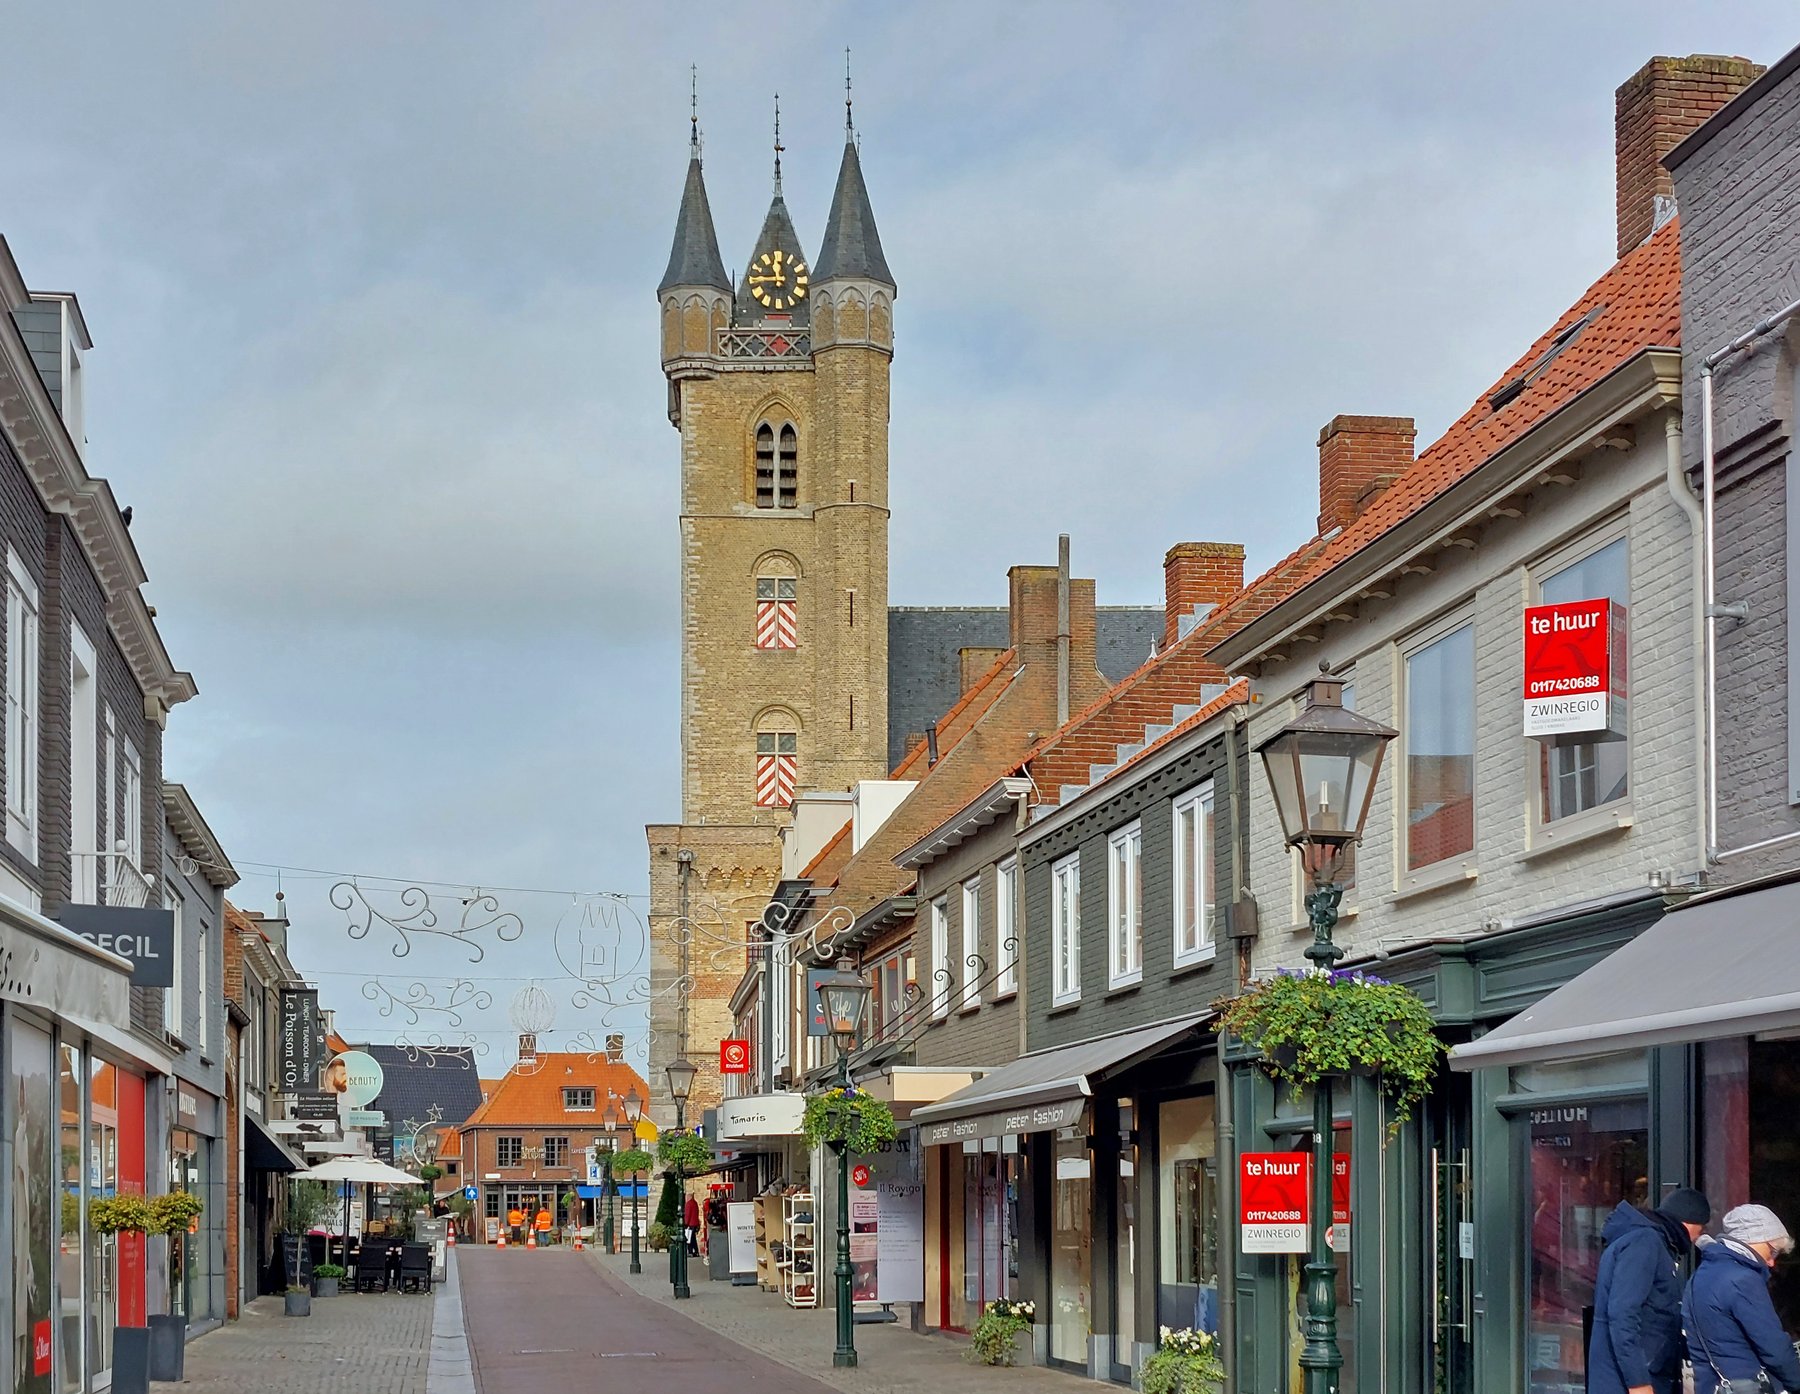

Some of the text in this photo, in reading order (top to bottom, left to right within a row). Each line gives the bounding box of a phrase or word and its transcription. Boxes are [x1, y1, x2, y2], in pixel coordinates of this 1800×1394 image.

[1531, 615, 1550, 635] te
[1553, 611, 1600, 632] huur
[1530, 675, 1600, 693] 0117420688
[1531, 699, 1600, 717] ZWINREGIO
[285, 994, 297, 1089] Le Poisson d'Or
[730, 1113, 766, 1125] Tamaris
[1005, 1114, 1029, 1132] peter
[1246, 1159, 1300, 1175] te huur
[1247, 1211, 1301, 1220] 0117420688
[1247, 1229, 1301, 1239] ZWINREGIO
